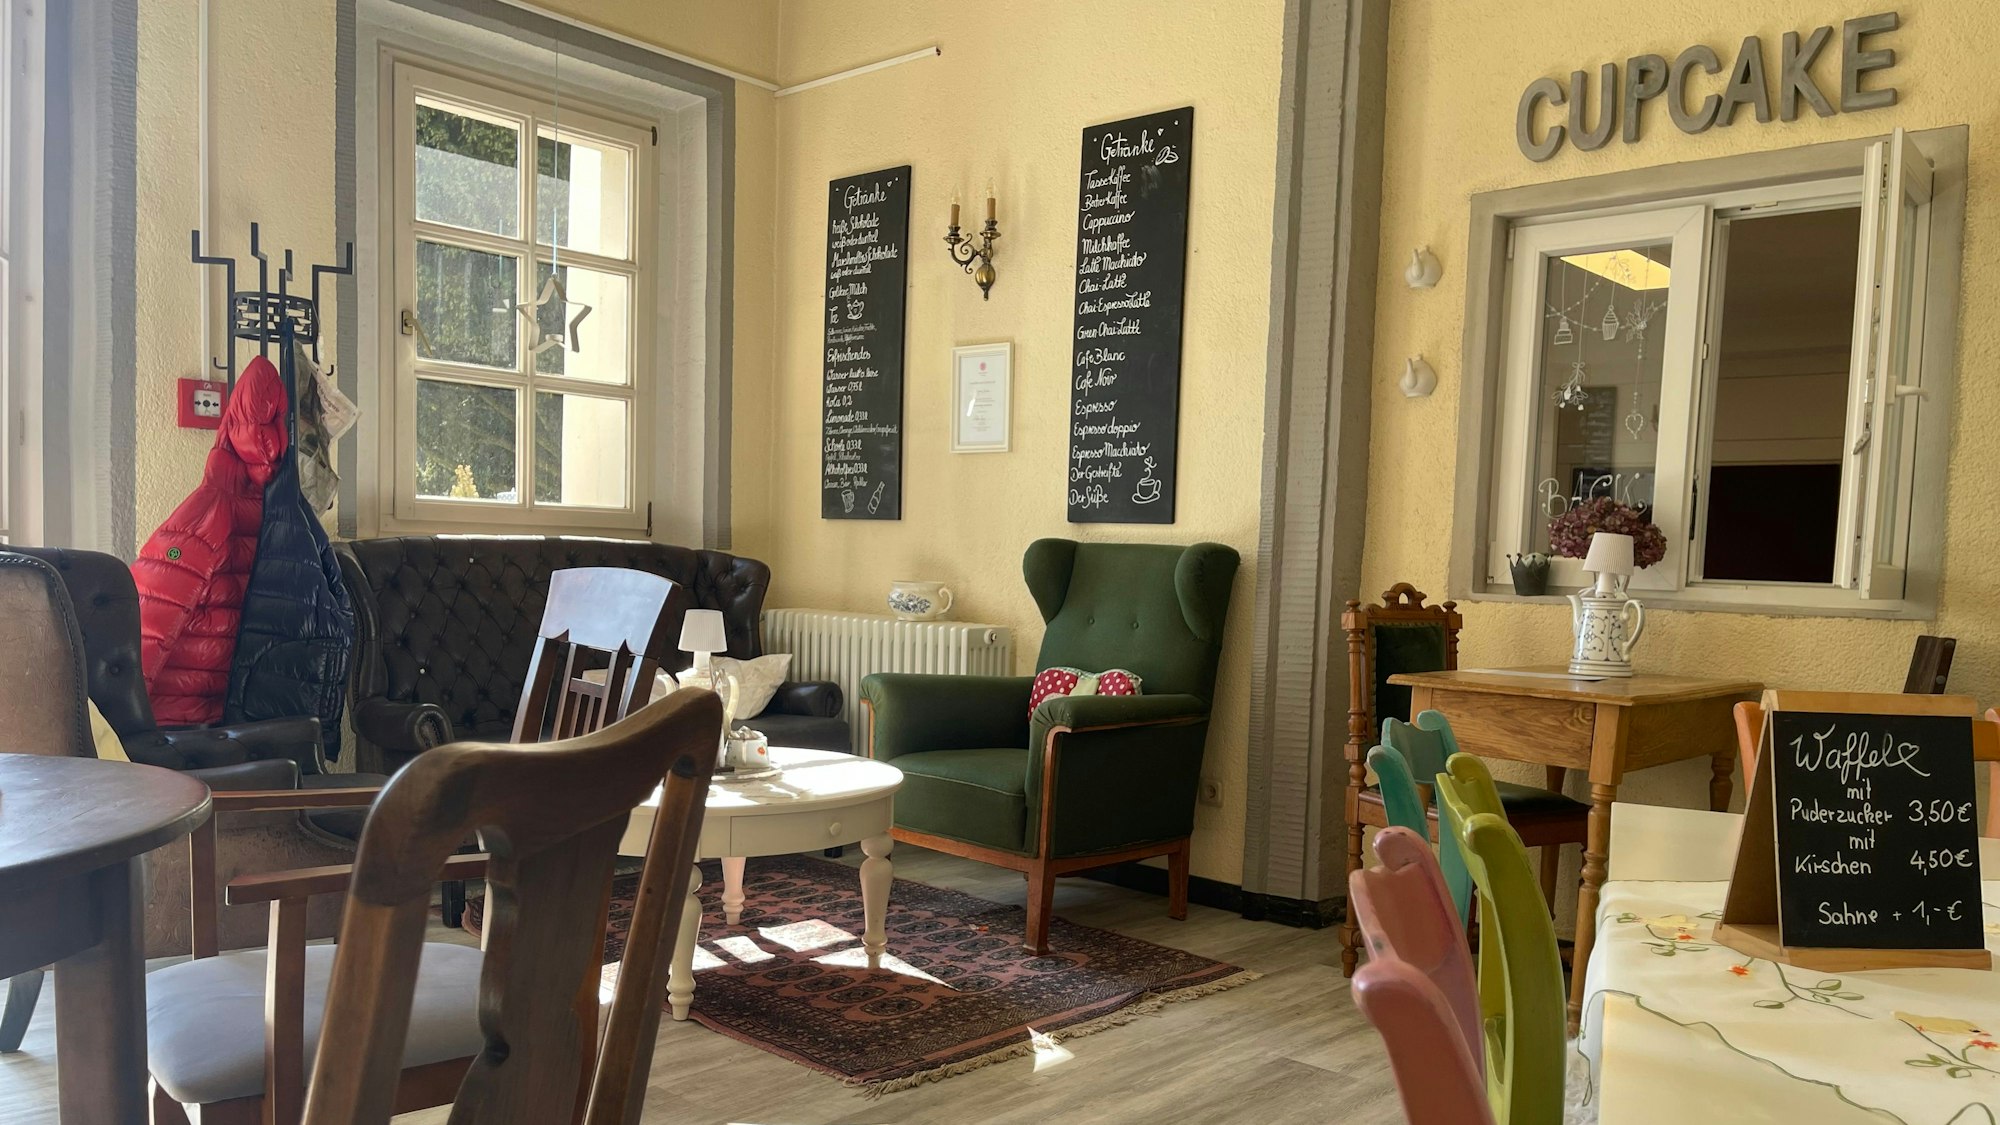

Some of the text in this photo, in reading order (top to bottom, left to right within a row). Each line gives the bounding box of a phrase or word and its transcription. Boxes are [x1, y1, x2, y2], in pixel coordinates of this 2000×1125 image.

[1516, 11, 1899, 163] CUPCAKE
[1101, 130, 1155, 165] Getränke
[1084, 165, 1131, 190] Tasse Kaffee
[844, 182, 887, 214] Getränke
[1083, 210, 1135, 234] Cappuccino
[1081, 232, 1131, 254] Milchkaffee
[1079, 251, 1147, 275] Latte Macchiato
[1093, 347, 1126, 365] Blanc
[1094, 367, 1118, 387] Noir
[1075, 399, 1118, 420] Espresso
[1073, 415, 1141, 441] Espresso doppio
[1072, 441, 1151, 469] Espresso Macchiato
[1082, 484, 1110, 509] Süße
[1790, 724, 1905, 784] Waffel
[1846, 777, 1872, 800] mit
[1790, 797, 1893, 825] Puderzucker
[1849, 828, 1876, 850] mit
[1795, 850, 1872, 875] Kirschen
[1818, 901, 1879, 926] Sahne
